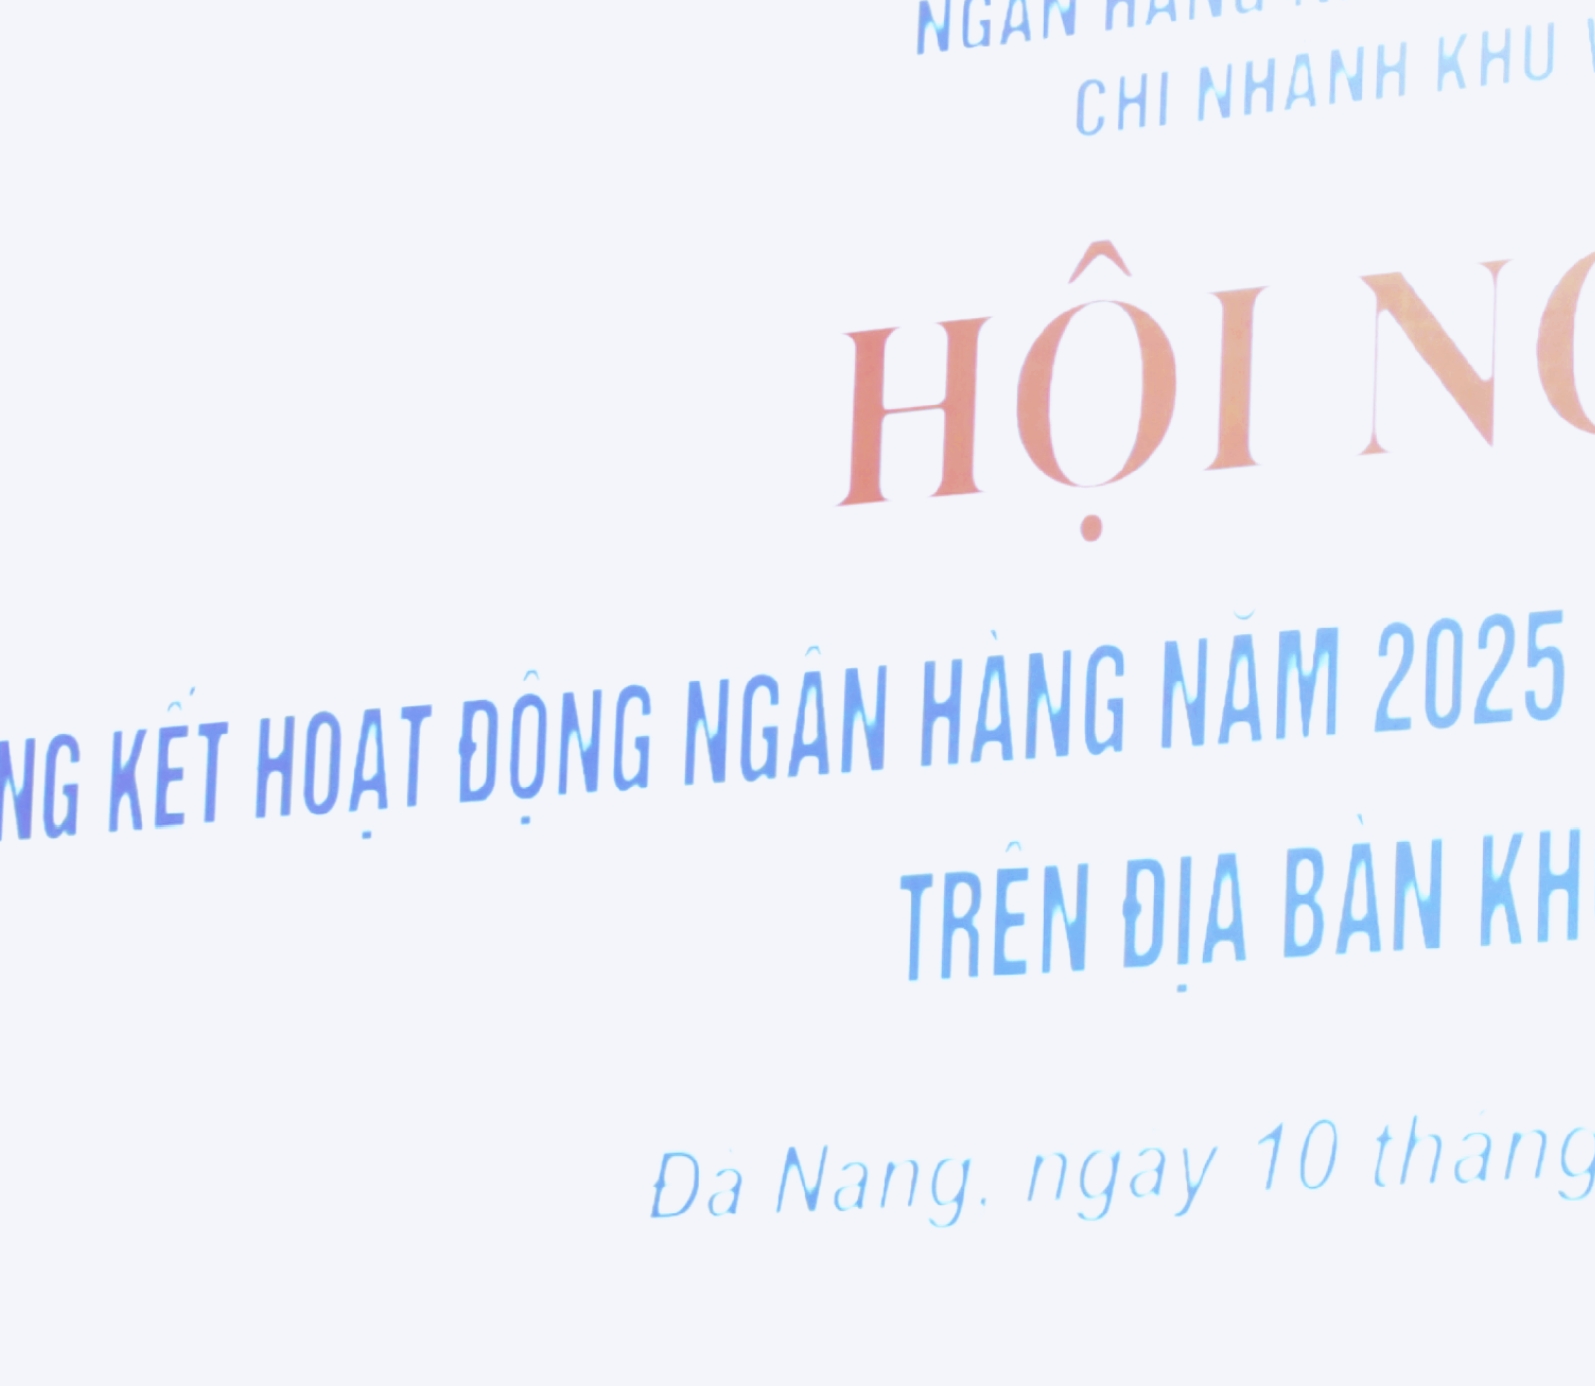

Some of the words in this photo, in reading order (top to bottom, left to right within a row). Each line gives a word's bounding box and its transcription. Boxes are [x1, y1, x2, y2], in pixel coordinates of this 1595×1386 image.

[1076, 71, 1169, 137] CHI
[1437, 22, 1555, 92] KHU
[836, 239, 1268, 542] HỘI
[108, 686, 229, 833] KẾT
[254, 704, 433, 840] HOẠT
[457, 668, 652, 826] ĐỘNG
[683, 644, 888, 786] NGÂN
[920, 629, 1125, 768] HÀNG
[1160, 610, 1340, 750] NĂM
[1373, 609, 1565, 733] 2025
[899, 840, 1090, 983] TRÊN
[1122, 851, 1247, 993] ĐỊA
[1283, 813, 1444, 959] BÀN
[1258, 1118, 1339, 1191] 10
